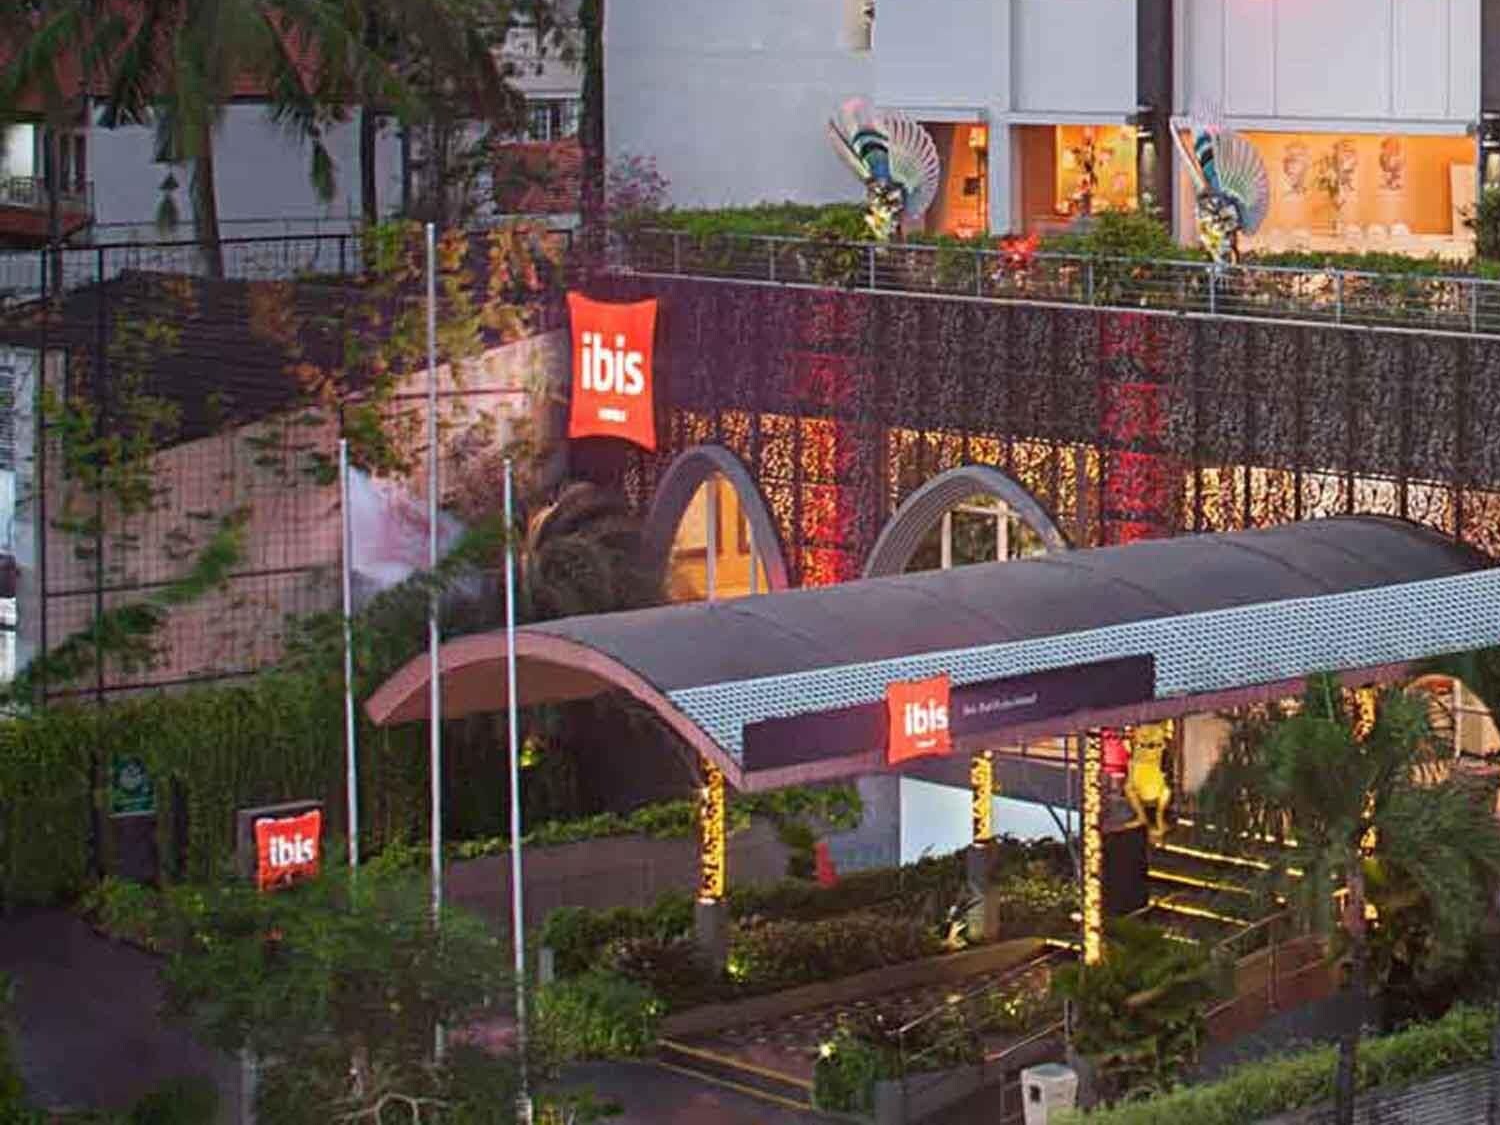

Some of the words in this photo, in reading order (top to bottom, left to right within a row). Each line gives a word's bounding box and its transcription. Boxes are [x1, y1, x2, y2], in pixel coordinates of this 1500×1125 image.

[581, 331, 645, 396] ibis
[905, 698, 949, 737] ibis
[269, 833, 314, 868] ibis
